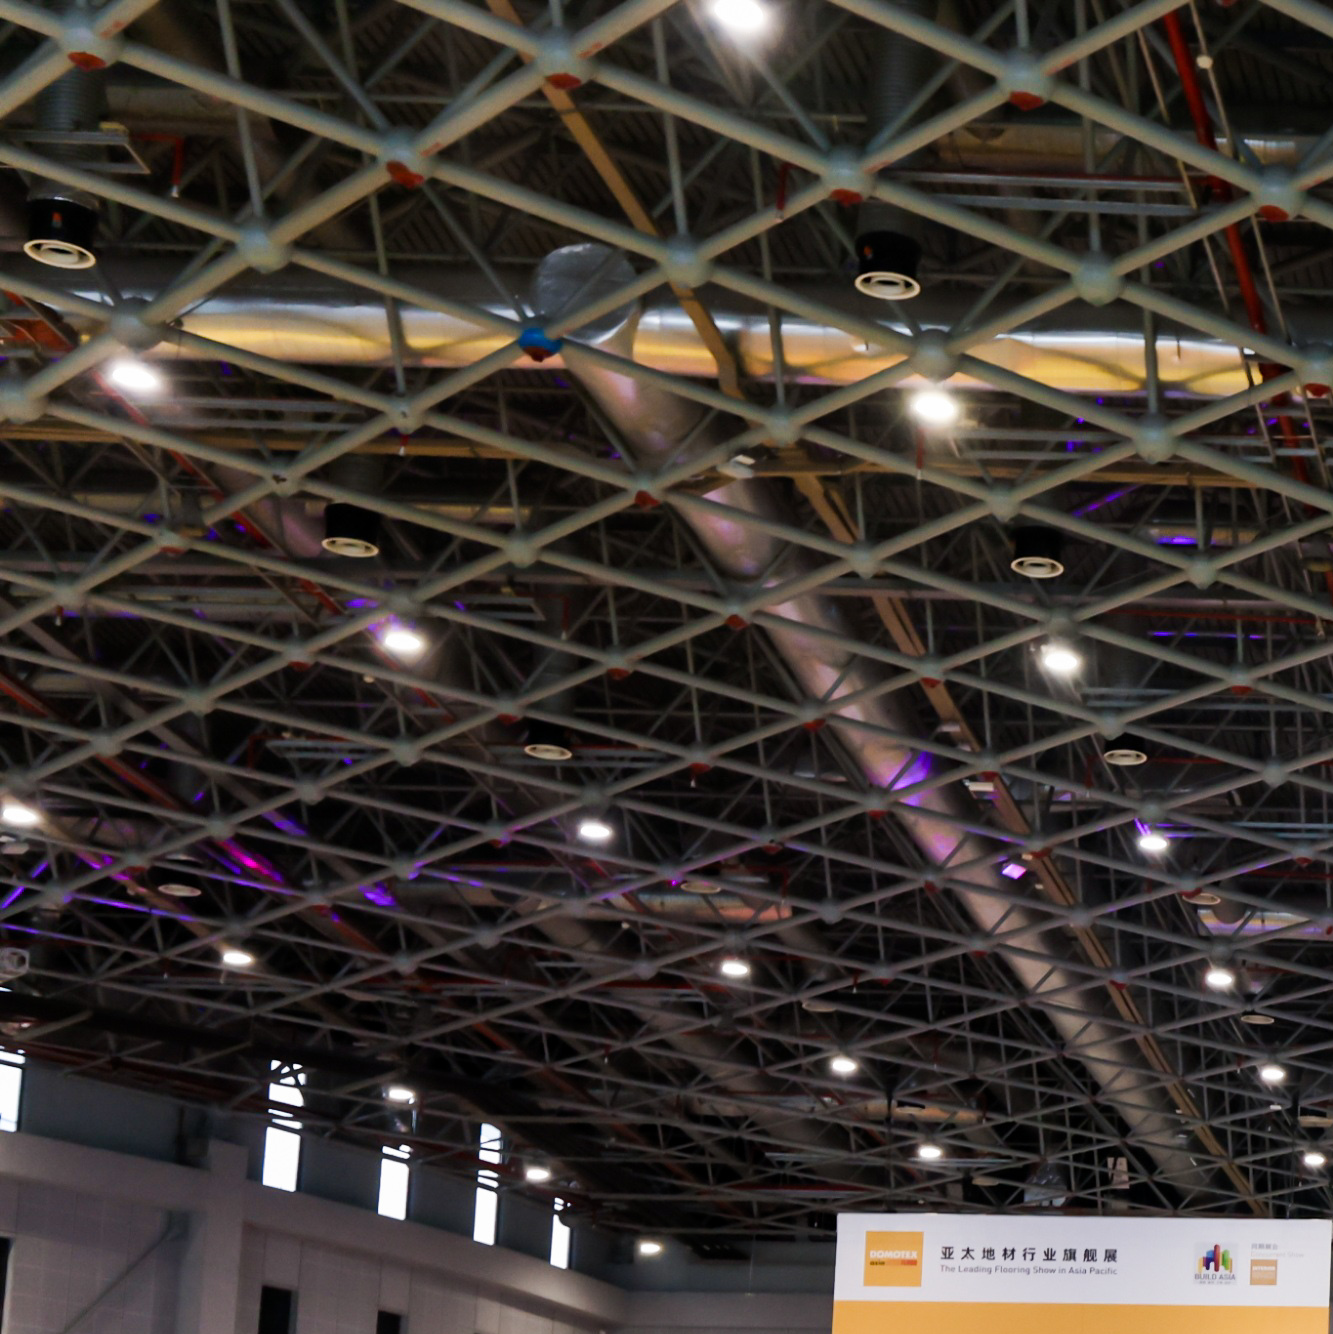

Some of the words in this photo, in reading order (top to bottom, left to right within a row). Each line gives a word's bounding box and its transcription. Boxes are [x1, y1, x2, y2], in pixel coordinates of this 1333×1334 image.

[869, 1250, 918, 1259] DOMOTEX
[940, 1246, 1118, 1263] 亚太地材行业旗舰展
[940, 1265, 956, 1273] The
[958, 1265, 992, 1275] Leading
[995, 1265, 1031, 1275] Flooring
[1033, 1266, 1057, 1274] Show
[1058, 1266, 1067, 1274] in
[1069, 1266, 1087, 1274] Asia
[1089, 1267, 1118, 1275] Pacific
